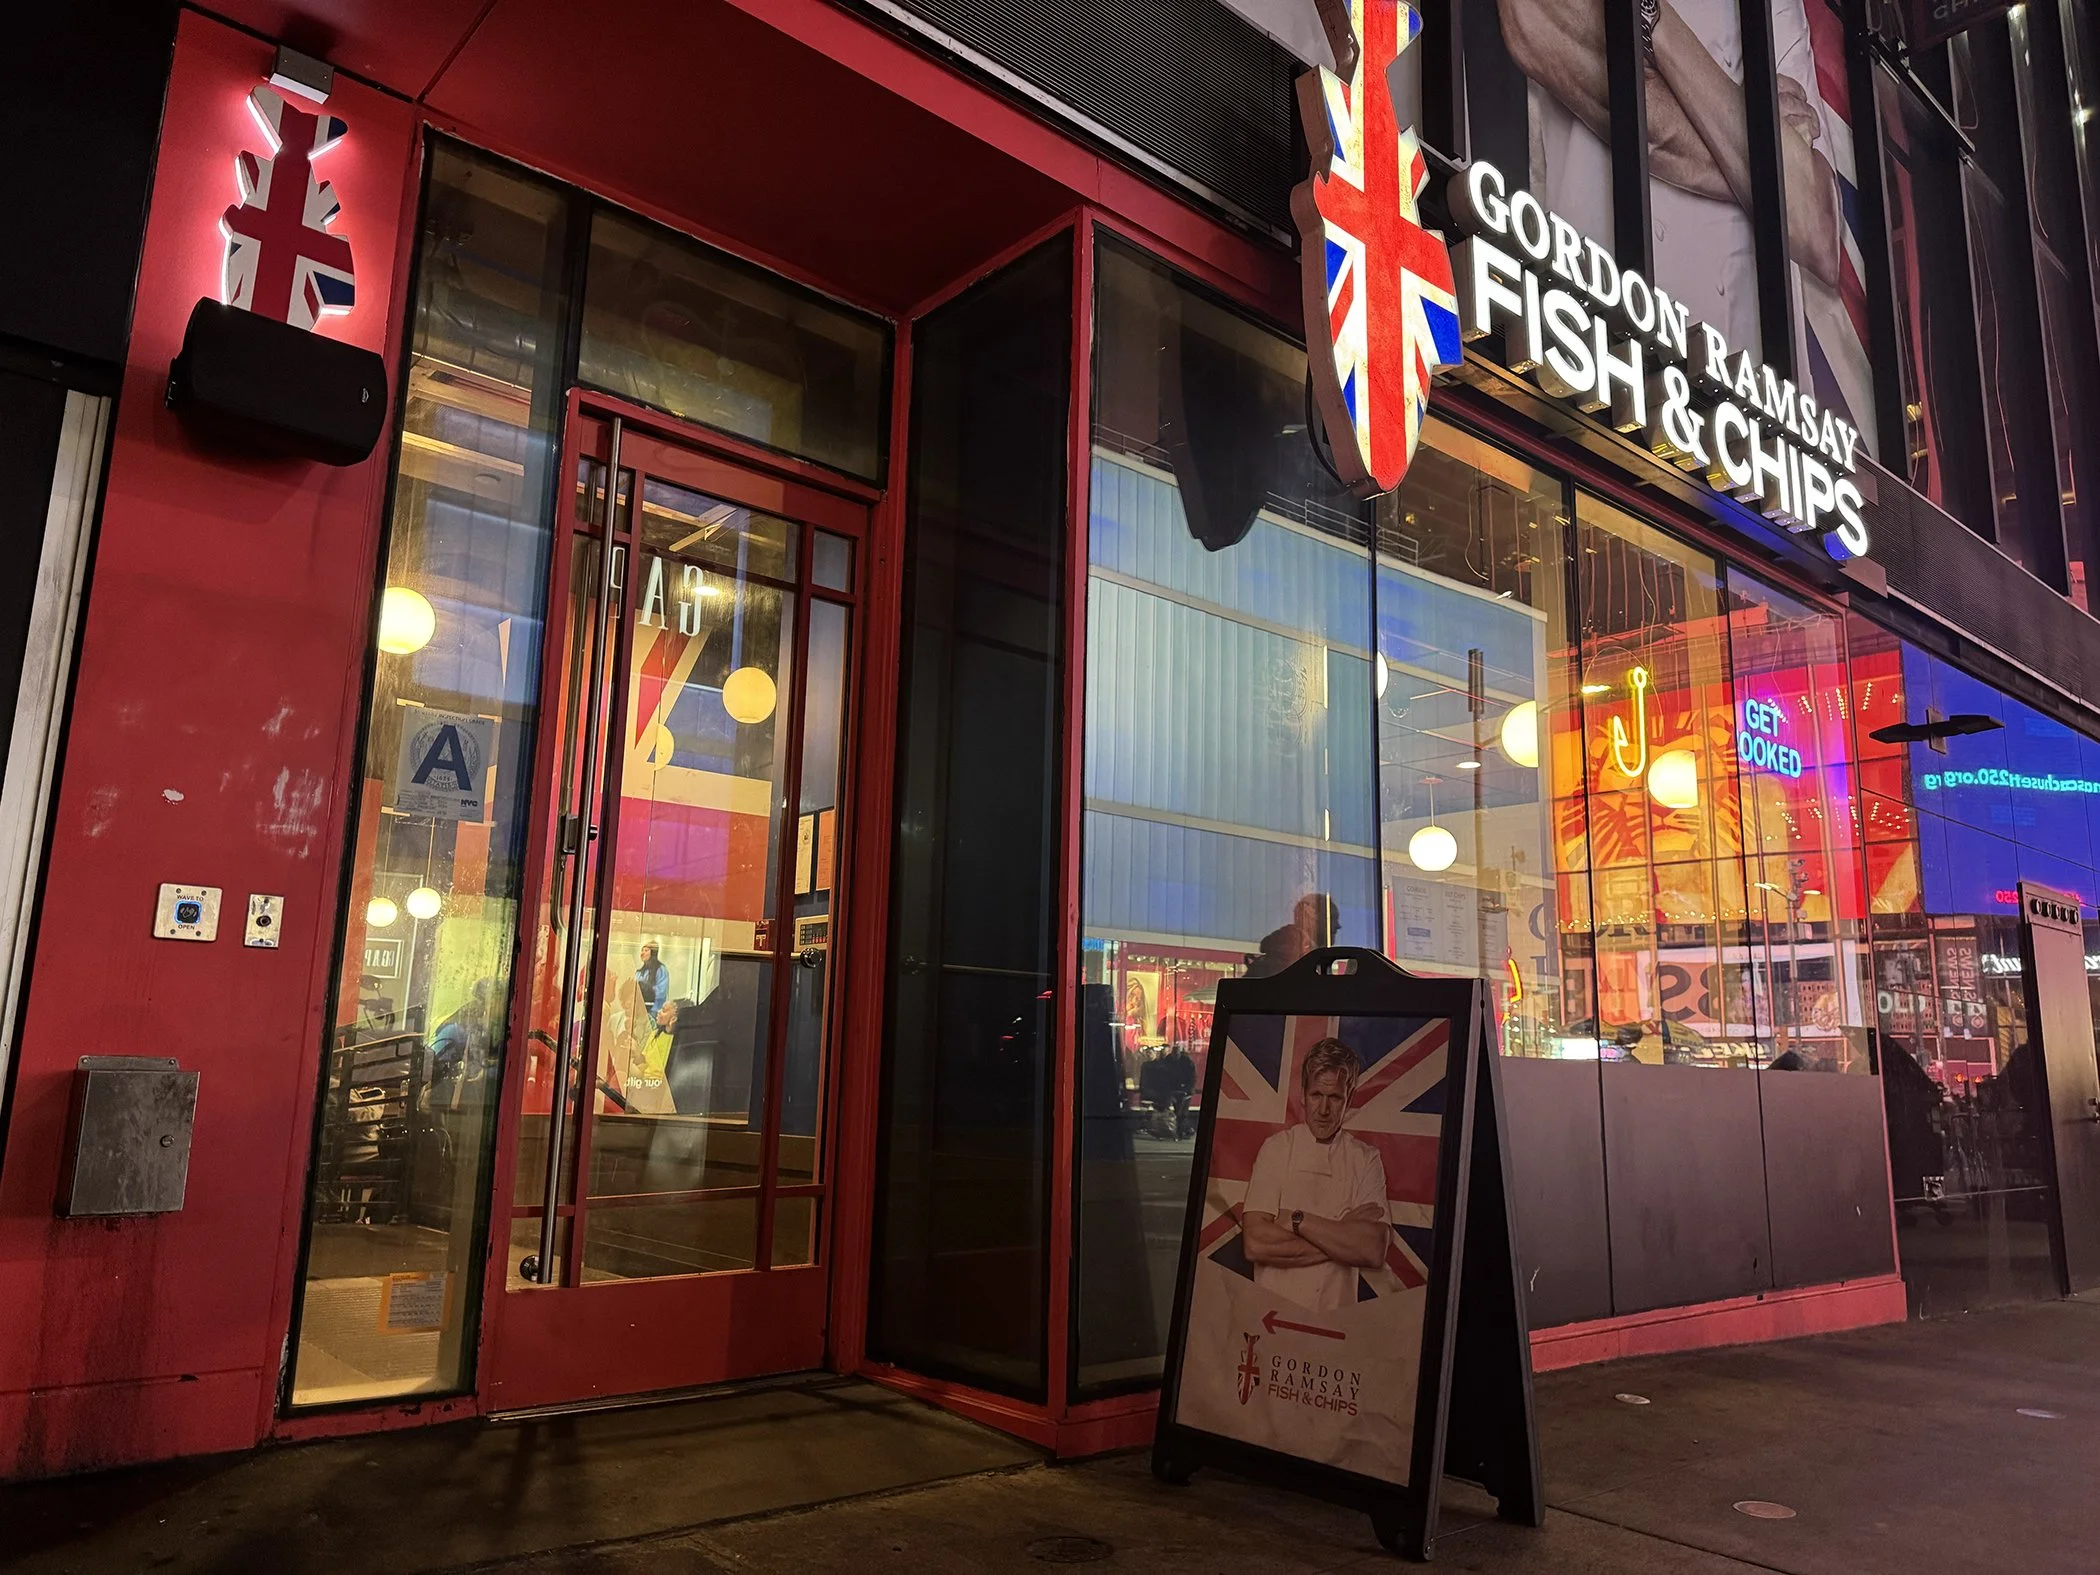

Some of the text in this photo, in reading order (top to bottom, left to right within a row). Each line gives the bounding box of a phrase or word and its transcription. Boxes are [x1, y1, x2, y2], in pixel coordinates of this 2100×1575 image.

[1468, 160, 1859, 475] GORDON RAMSAY
[1472, 234, 1869, 559] FISH & CHIPS
[1745, 698, 1779, 737] GET
[411, 724, 472, 792] A
[1737, 731, 1802, 779] OOKED
[1270, 1369, 1360, 1400] RAMSAY
[1271, 1355, 1361, 1386] GORDON
[1267, 1383, 1358, 1416] FISH & CHIPS
